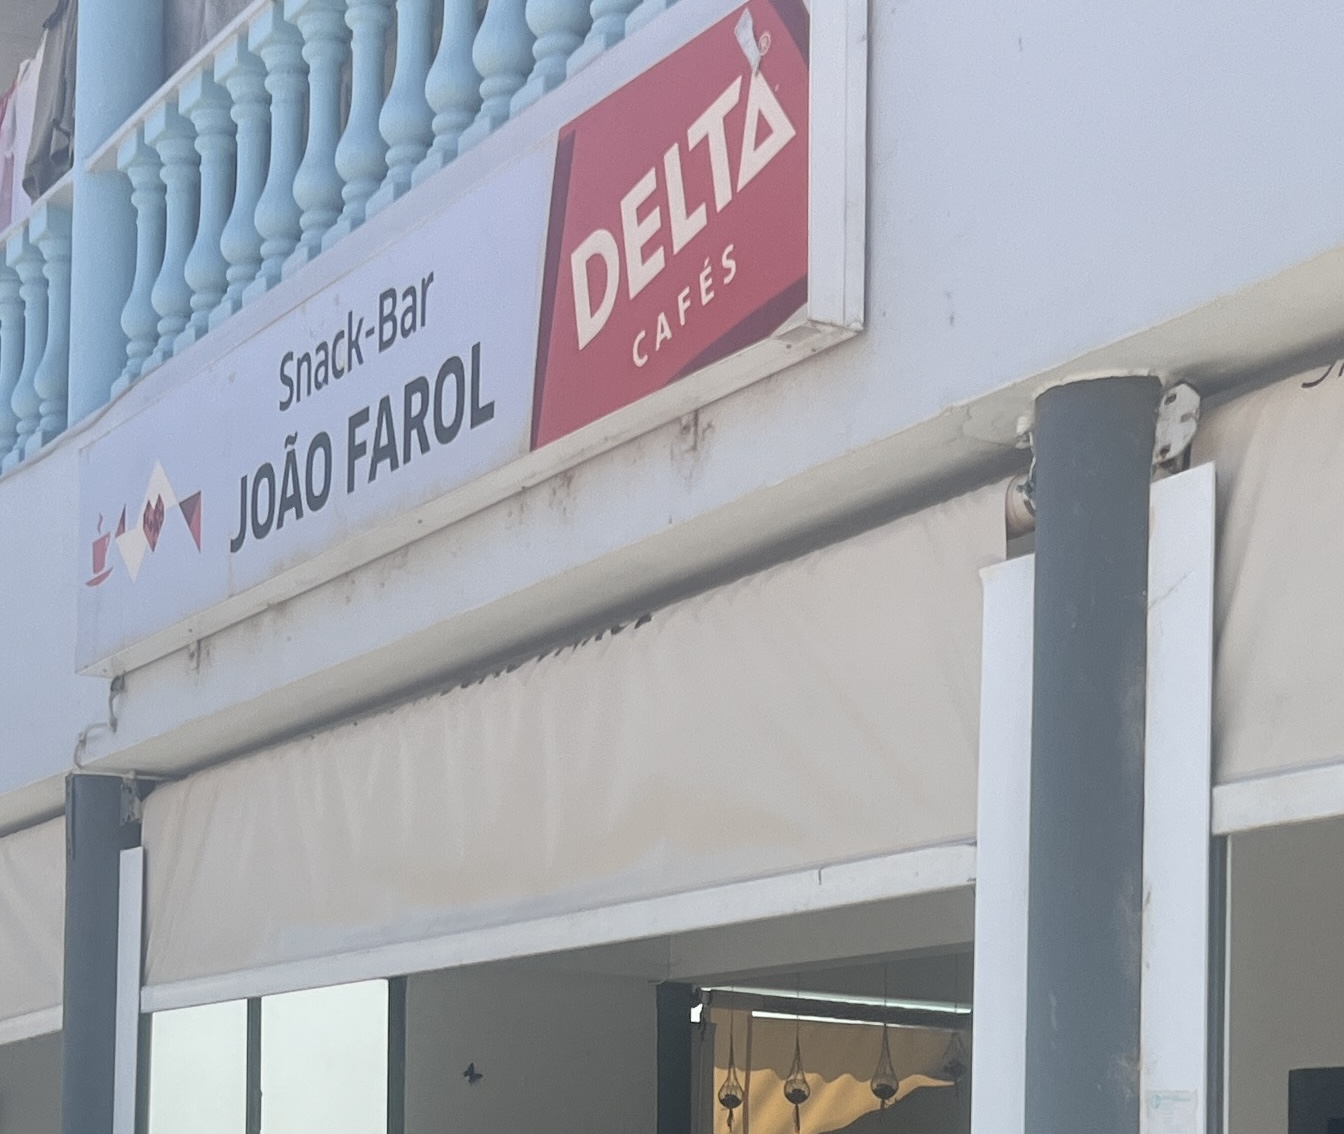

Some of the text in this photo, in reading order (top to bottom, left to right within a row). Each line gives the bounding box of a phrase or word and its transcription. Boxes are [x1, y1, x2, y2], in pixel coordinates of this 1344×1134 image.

[570, 69, 797, 351] DELTA
[279, 271, 435, 412] Snack-Bar
[631, 243, 738, 368] CAFÉS
[229, 341, 496, 554] JOÃO FAROL
